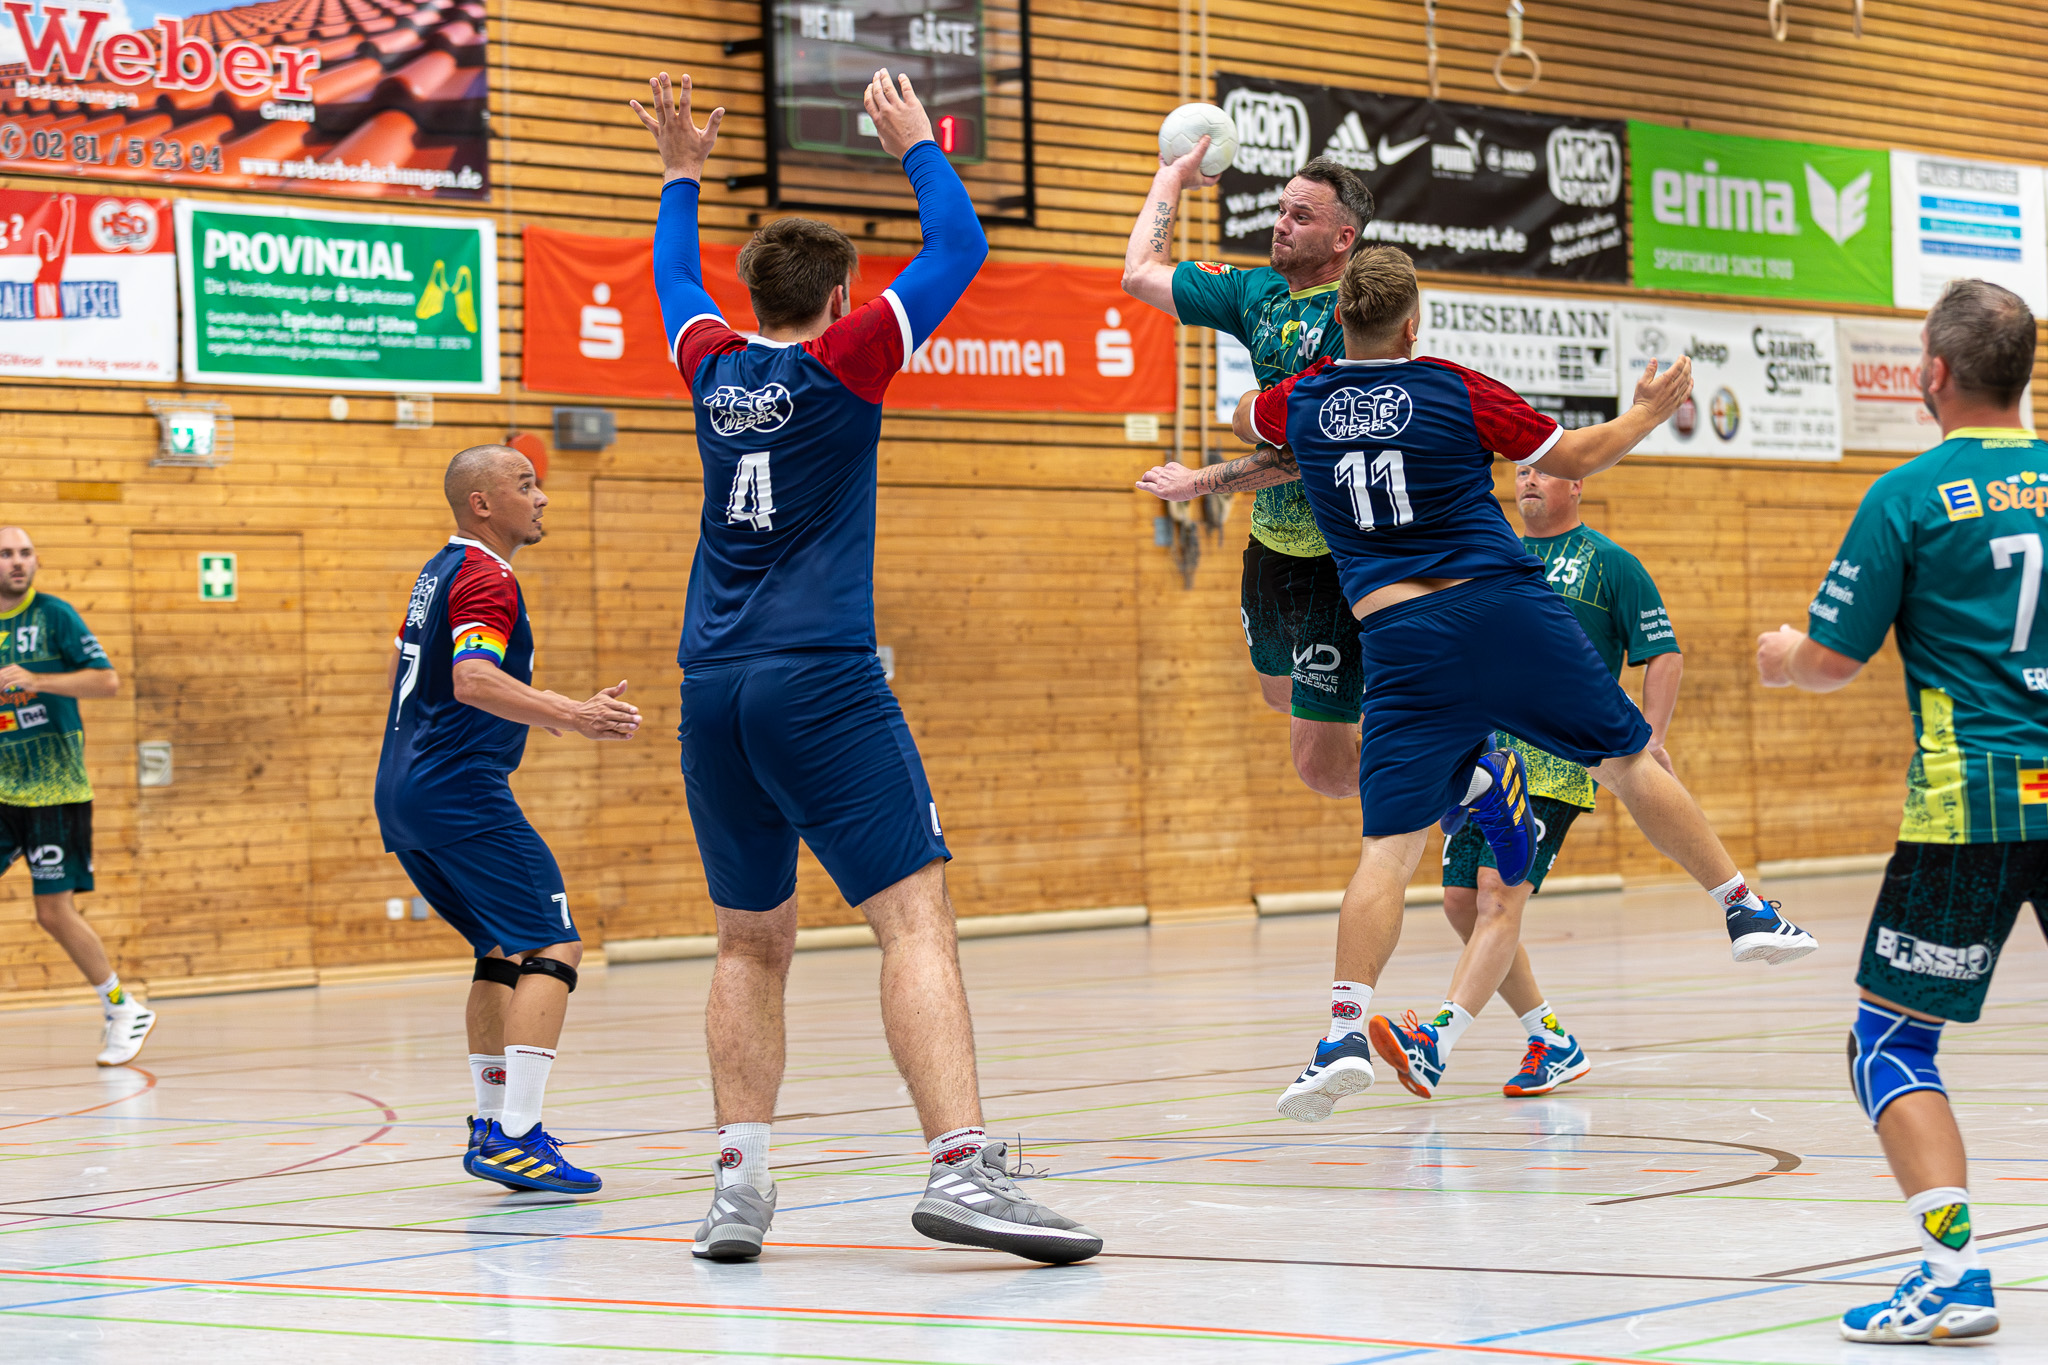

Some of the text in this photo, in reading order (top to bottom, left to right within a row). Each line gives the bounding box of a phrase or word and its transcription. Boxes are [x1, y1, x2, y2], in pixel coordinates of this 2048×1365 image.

[801, 5, 976, 56] HEIM GÄSTE
[3, 2, 320, 100] Weber
[15, 79, 139, 109] Bedachungen
[260, 101, 315, 122] GmbH
[33, 131, 64, 159] 02
[73, 134, 100, 162] 81
[128, 139, 144, 164] 5
[153, 142, 183, 170] 23
[191, 145, 222, 171] 94
[939, 115, 954, 153] 1
[239, 155, 483, 190] www.weberbedachungen.de
[1652, 159, 1797, 235] erima
[203, 228, 414, 282] PROVINZIAL
[1653, 248, 1728, 275] SPORTSWEAR
[1732, 255, 1764, 278] SINCE
[0, 283, 34, 318] ALL
[1430, 301, 1609, 338] BIESEMANN
[901, 336, 1066, 377] kommen
[1684, 335, 1728, 368] Jeep
[1766, 362, 1831, 393] SCHMITZ
[724, 411, 772, 431] WESEL
[1329, 394, 1399, 426] HSG
[1336, 418, 1387, 437] WESEL
[726, 451, 777, 532] 4
[1334, 450, 1414, 532] 11
[1546, 556, 1583, 585] 25
[1989, 533, 2043, 653] 7
[464, 633, 484, 651] C
[395, 642, 421, 725] 7
[2022, 667, 2048, 691] ER
[551, 892, 572, 930] 7
